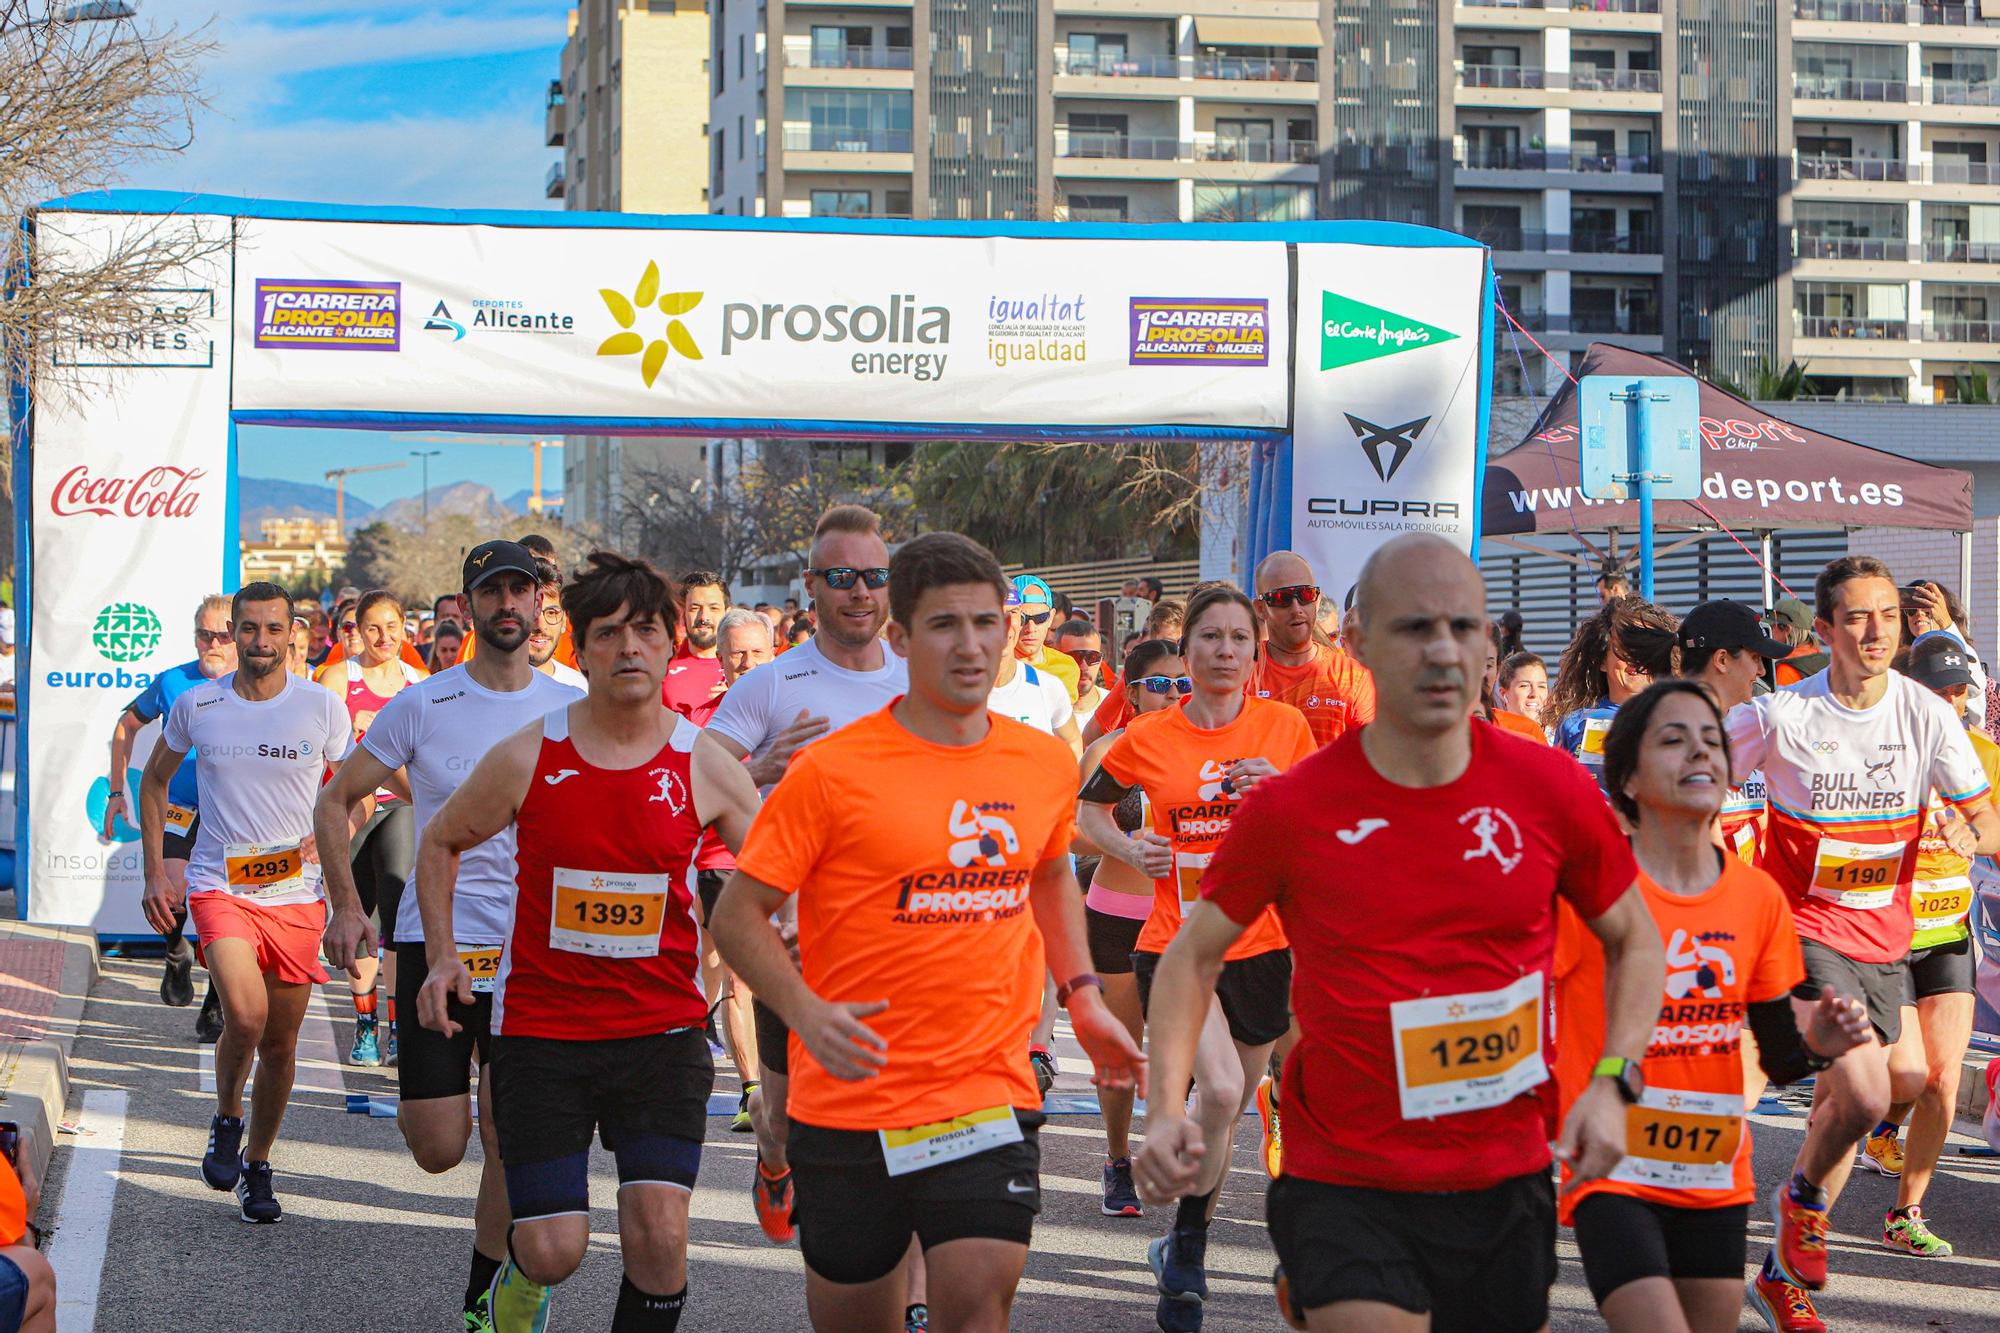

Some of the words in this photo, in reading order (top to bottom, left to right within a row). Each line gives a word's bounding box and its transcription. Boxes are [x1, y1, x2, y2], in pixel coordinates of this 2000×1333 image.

[277, 293, 396, 310] CARRERA
[472, 299, 523, 308] DEPORTES
[989, 293, 1085, 323] igualtat
[273, 309, 395, 327] PROSOLIA
[473, 309, 574, 329] Alicante
[721, 294, 950, 355] prosolia
[1151, 311, 1264, 326] CARRERA
[260, 326, 334, 336] ALICANTE
[345, 328, 395, 338] MUJER
[1148, 327, 1264, 343] PROSOLIA
[1324, 320, 1340, 337] El
[1341, 322, 1376, 339] Corte
[1378, 319, 1430, 346] Inglés
[79, 333, 188, 350] HOMES
[1136, 343, 1206, 352] ALICANTE
[1216, 344, 1264, 353] MUJER
[988, 338, 1085, 367] igualdad
[851, 352, 948, 381] energy
[1725, 437, 1758, 452] Chip
[1307, 498, 1459, 519] CUPRA
[1307, 518, 1377, 531] AUTOMÓVILES
[1379, 521, 1402, 531] SALA
[1405, 522, 1459, 533] RODRÍGUEZ
[47, 667, 160, 688] euroba
[431, 692, 457, 704] luanvi
[1811, 773, 1858, 792] BULL
[1811, 791, 1905, 811] RUNNERS
[1178, 804, 1238, 819] CARR
[240, 859, 289, 878] 1293
[1834, 866, 1887, 884] 1190
[915, 869, 1030, 890] CARRER
[909, 884, 1030, 912] PROSOLI
[1919, 896, 1960, 913] 1023
[574, 901, 645, 926] 1393
[892, 911, 980, 924] ALICANTE
[1430, 1024, 1520, 1068] 1290
[929, 1127, 977, 1145] PROSOLIA
[1644, 1122, 1722, 1152] 1017
